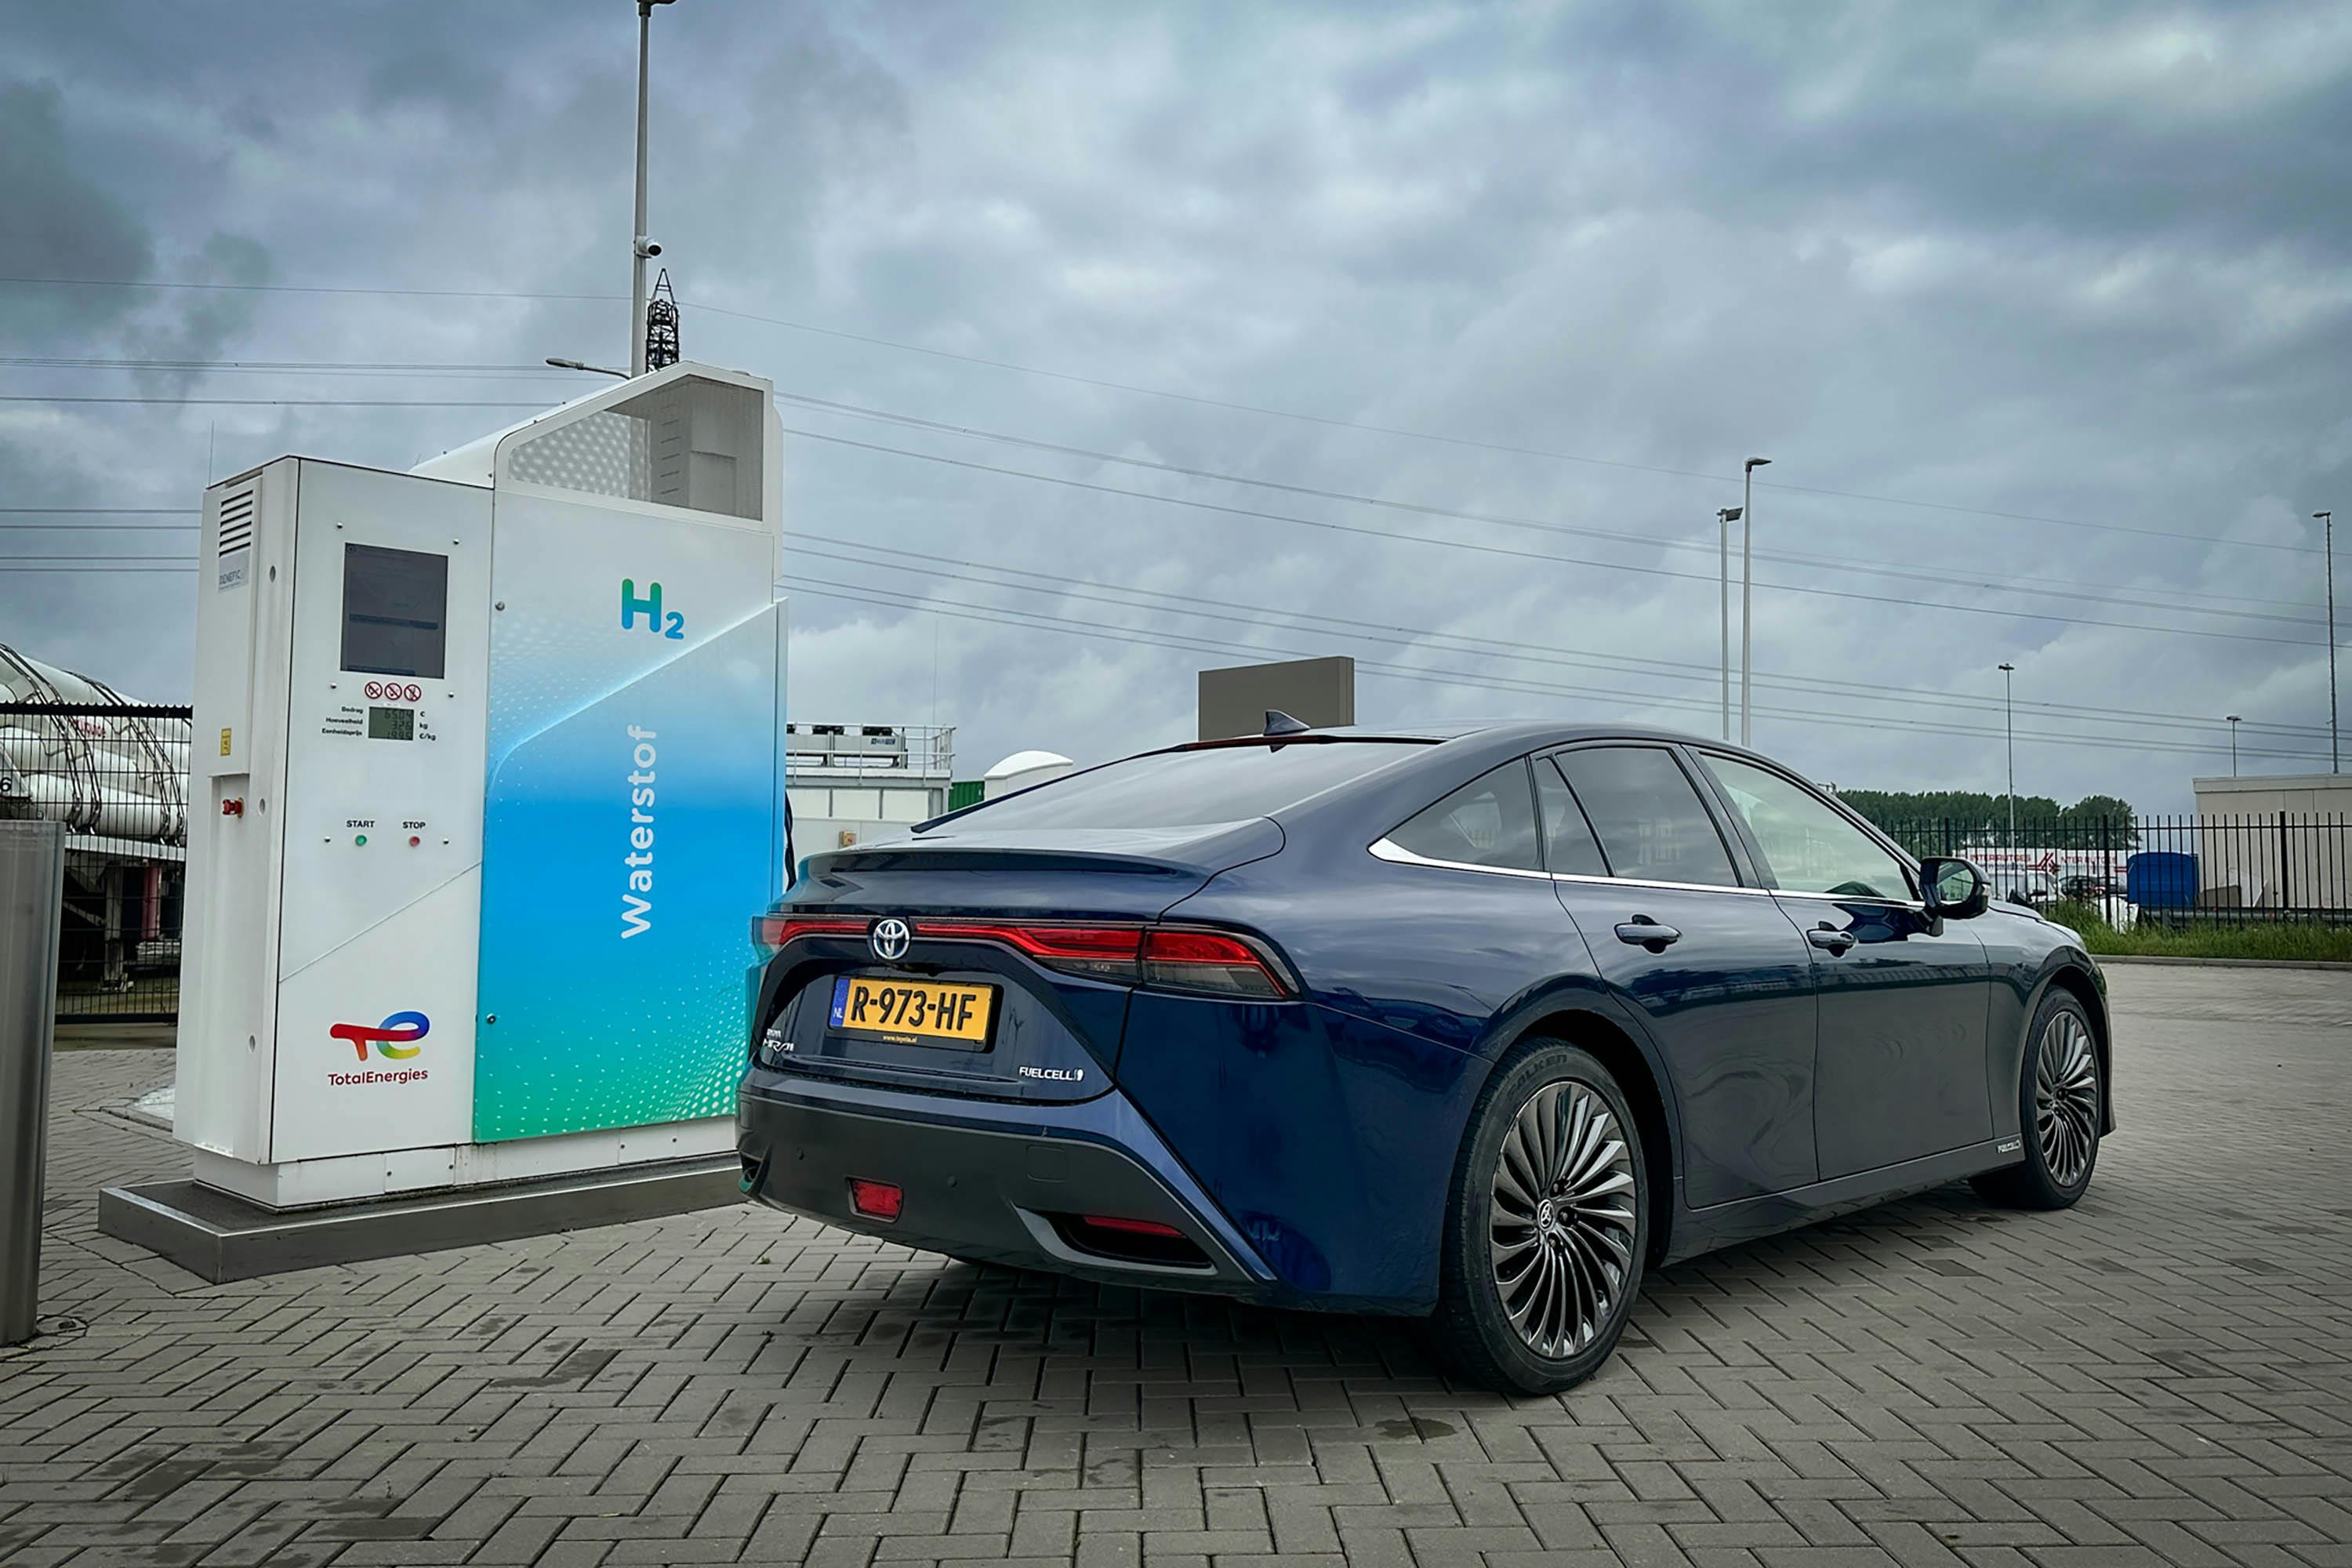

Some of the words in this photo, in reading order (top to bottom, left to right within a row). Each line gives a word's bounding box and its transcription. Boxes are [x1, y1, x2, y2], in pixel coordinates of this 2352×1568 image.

[342, 706, 363, 714] Bedrag
[321, 728, 362, 736] Eenheidsprijs
[402, 821, 426, 829] STOP
[620, 724, 658, 939] Waterstof
[833, 1007, 844, 1019] NL
[850, 985, 977, 1032] R-973-HF
[328, 1068, 428, 1086] TotalEnergies
